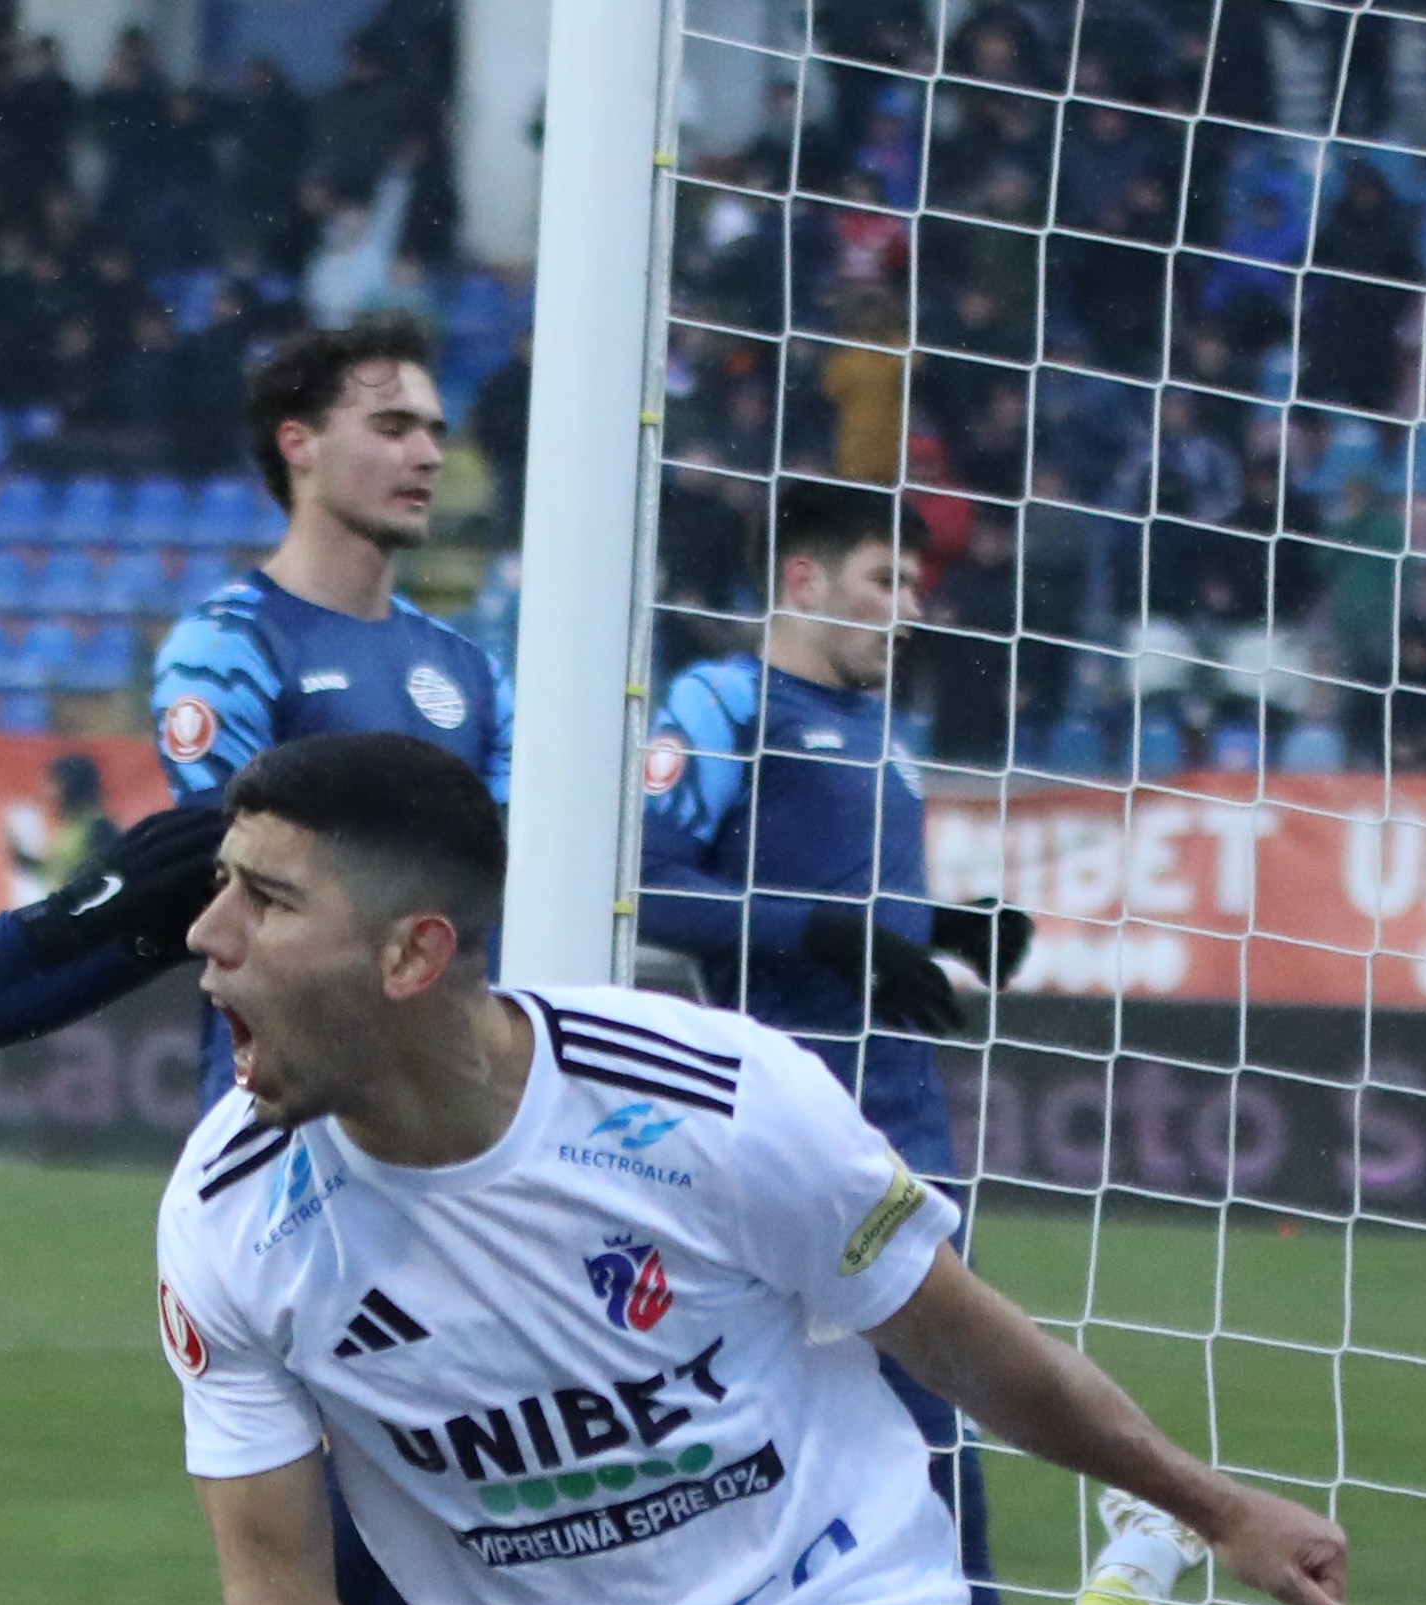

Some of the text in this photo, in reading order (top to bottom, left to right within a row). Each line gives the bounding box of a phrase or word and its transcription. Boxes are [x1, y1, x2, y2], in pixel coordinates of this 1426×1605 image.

[927, 804, 1281, 916] NIBET
[559, 1145, 692, 1189] ELECTROALFA
[945, 1062, 1289, 1188] acto
[379, 1335, 729, 1481] UNIBET
[470, 1462, 770, 1566] MPREUNĂ SPRE 0%
